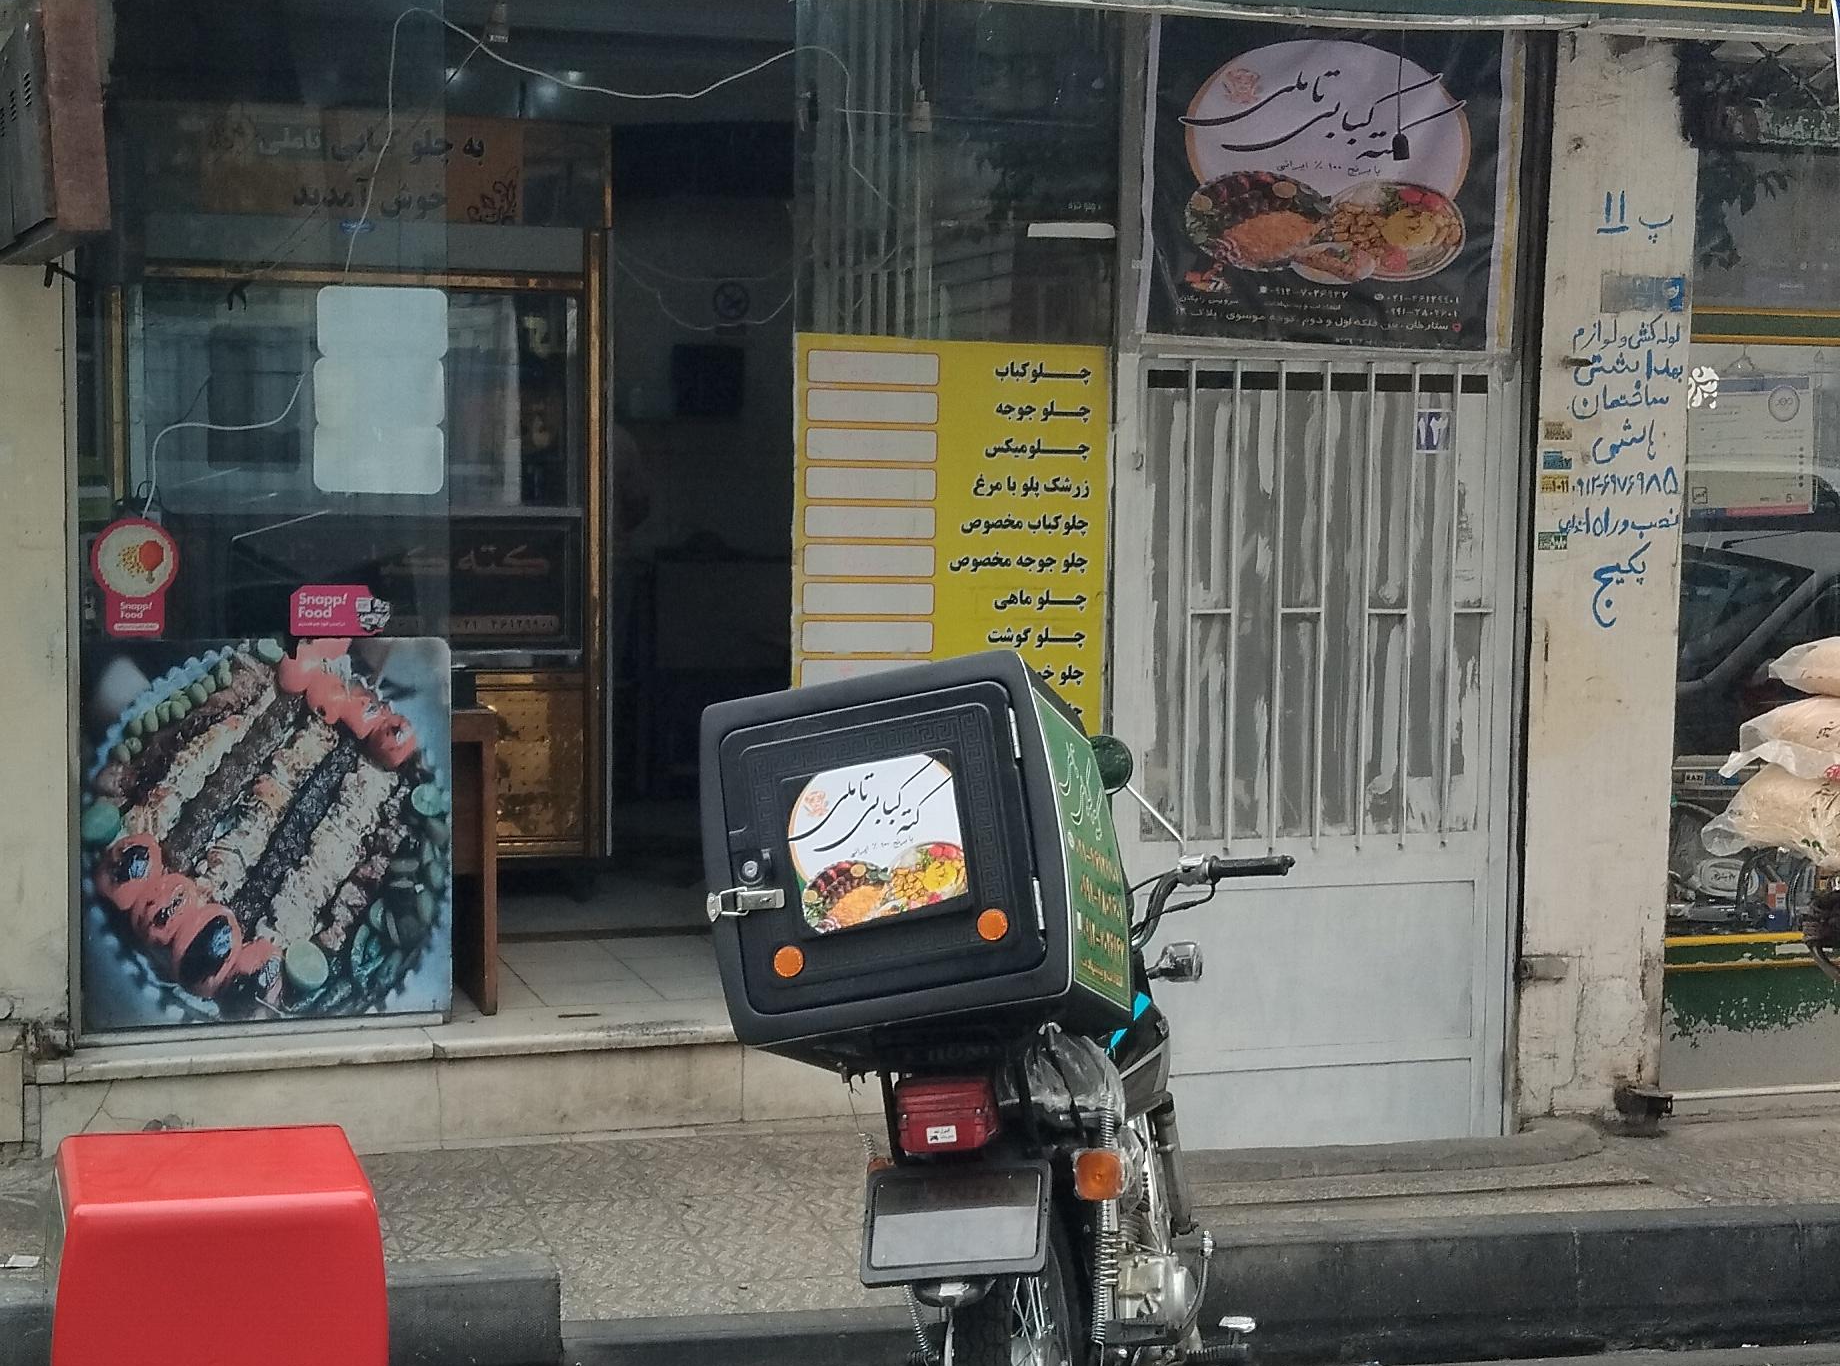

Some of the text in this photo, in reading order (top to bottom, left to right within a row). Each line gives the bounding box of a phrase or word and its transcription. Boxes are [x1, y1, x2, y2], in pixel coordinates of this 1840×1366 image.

[1177, 68, 1341, 127] تاملی
[995, 402, 1037, 422] جوجه
[972, 474, 1089, 499] زرشک پلو با مرغ
[960, 516, 1023, 535] مخصوص
[949, 551, 1088, 574] چلو جوجه مخصوص
[298, 592, 348, 608] Snapp!
[994, 589, 1032, 611] ماهی
[298, 606, 333, 619] Food
[987, 628, 1031, 648] گوشت
[1058, 664, 1085, 686] چلو
[788, 771, 875, 842] تاملی
[812, 758, 935, 853] کبابی
